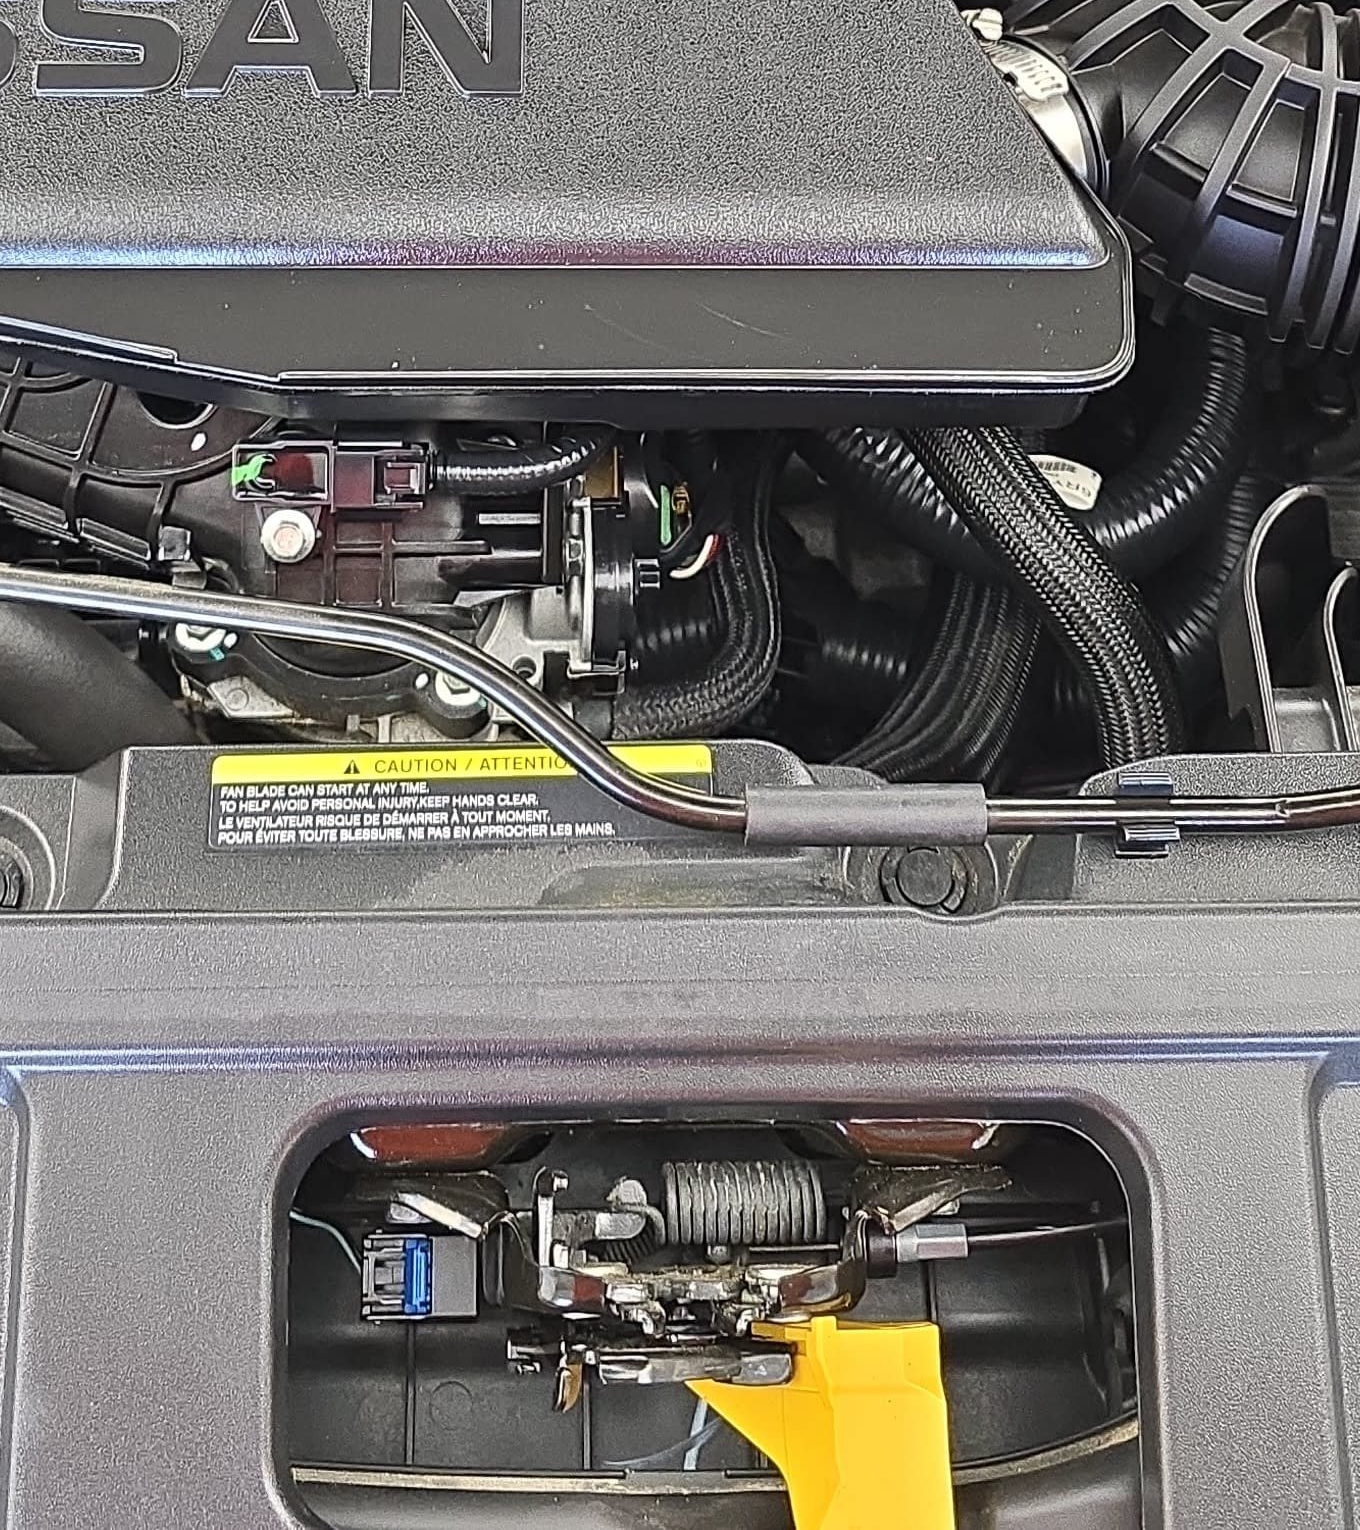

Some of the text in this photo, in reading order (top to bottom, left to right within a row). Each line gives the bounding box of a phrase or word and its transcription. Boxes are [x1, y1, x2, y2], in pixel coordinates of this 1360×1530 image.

[374, 757, 457, 774] CAUTION
[480, 755, 567, 771] ATTENTIO
[220, 781, 430, 798] FAN BLADE CAN START AT ANY TIME.
[220, 800, 237, 813] TO
[240, 799, 270, 812] HELP
[272, 798, 309, 811] AVOID
[311, 797, 375, 810] PERSONAL
[452, 794, 494, 807] HANDS
[497, 793, 539, 806] CLEAR.
[219, 808, 551, 830] LE VENTILATEUR RISQUE DE DÉMARRER À TOUT MOMENT.
[218, 822, 616, 845] POUR ÉVITER TOUTE BLESSURE, NE PAS EN APPROCHER LES MAINS.
